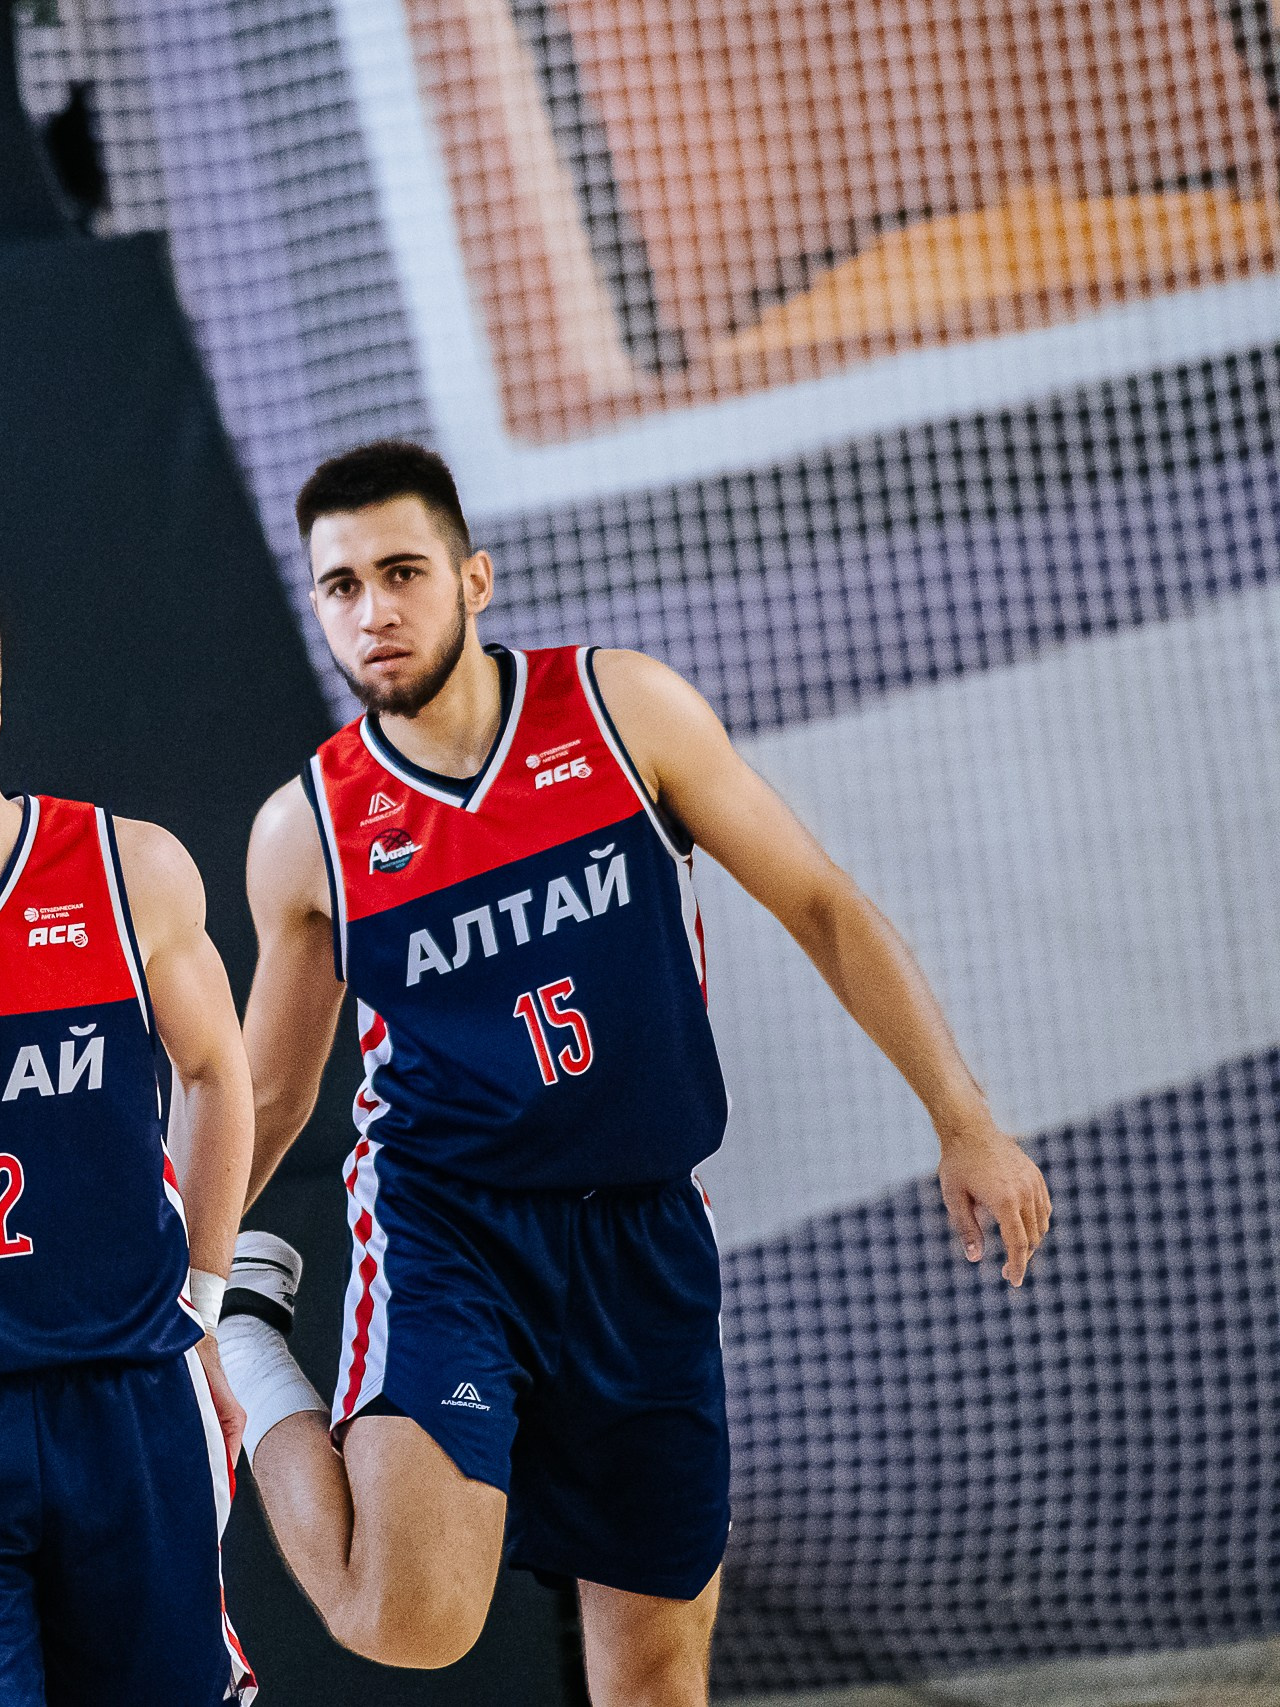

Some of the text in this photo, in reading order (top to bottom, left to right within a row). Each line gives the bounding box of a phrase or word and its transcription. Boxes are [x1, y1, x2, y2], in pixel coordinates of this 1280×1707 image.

[534, 755, 593, 790] АСБ
[406, 843, 631, 987] АЛТАЙ
[28, 922, 89, 948] АСБ
[513, 976, 595, 1086] 15
[440, 1399, 491, 1412] АЛЬФАСПОРТ
